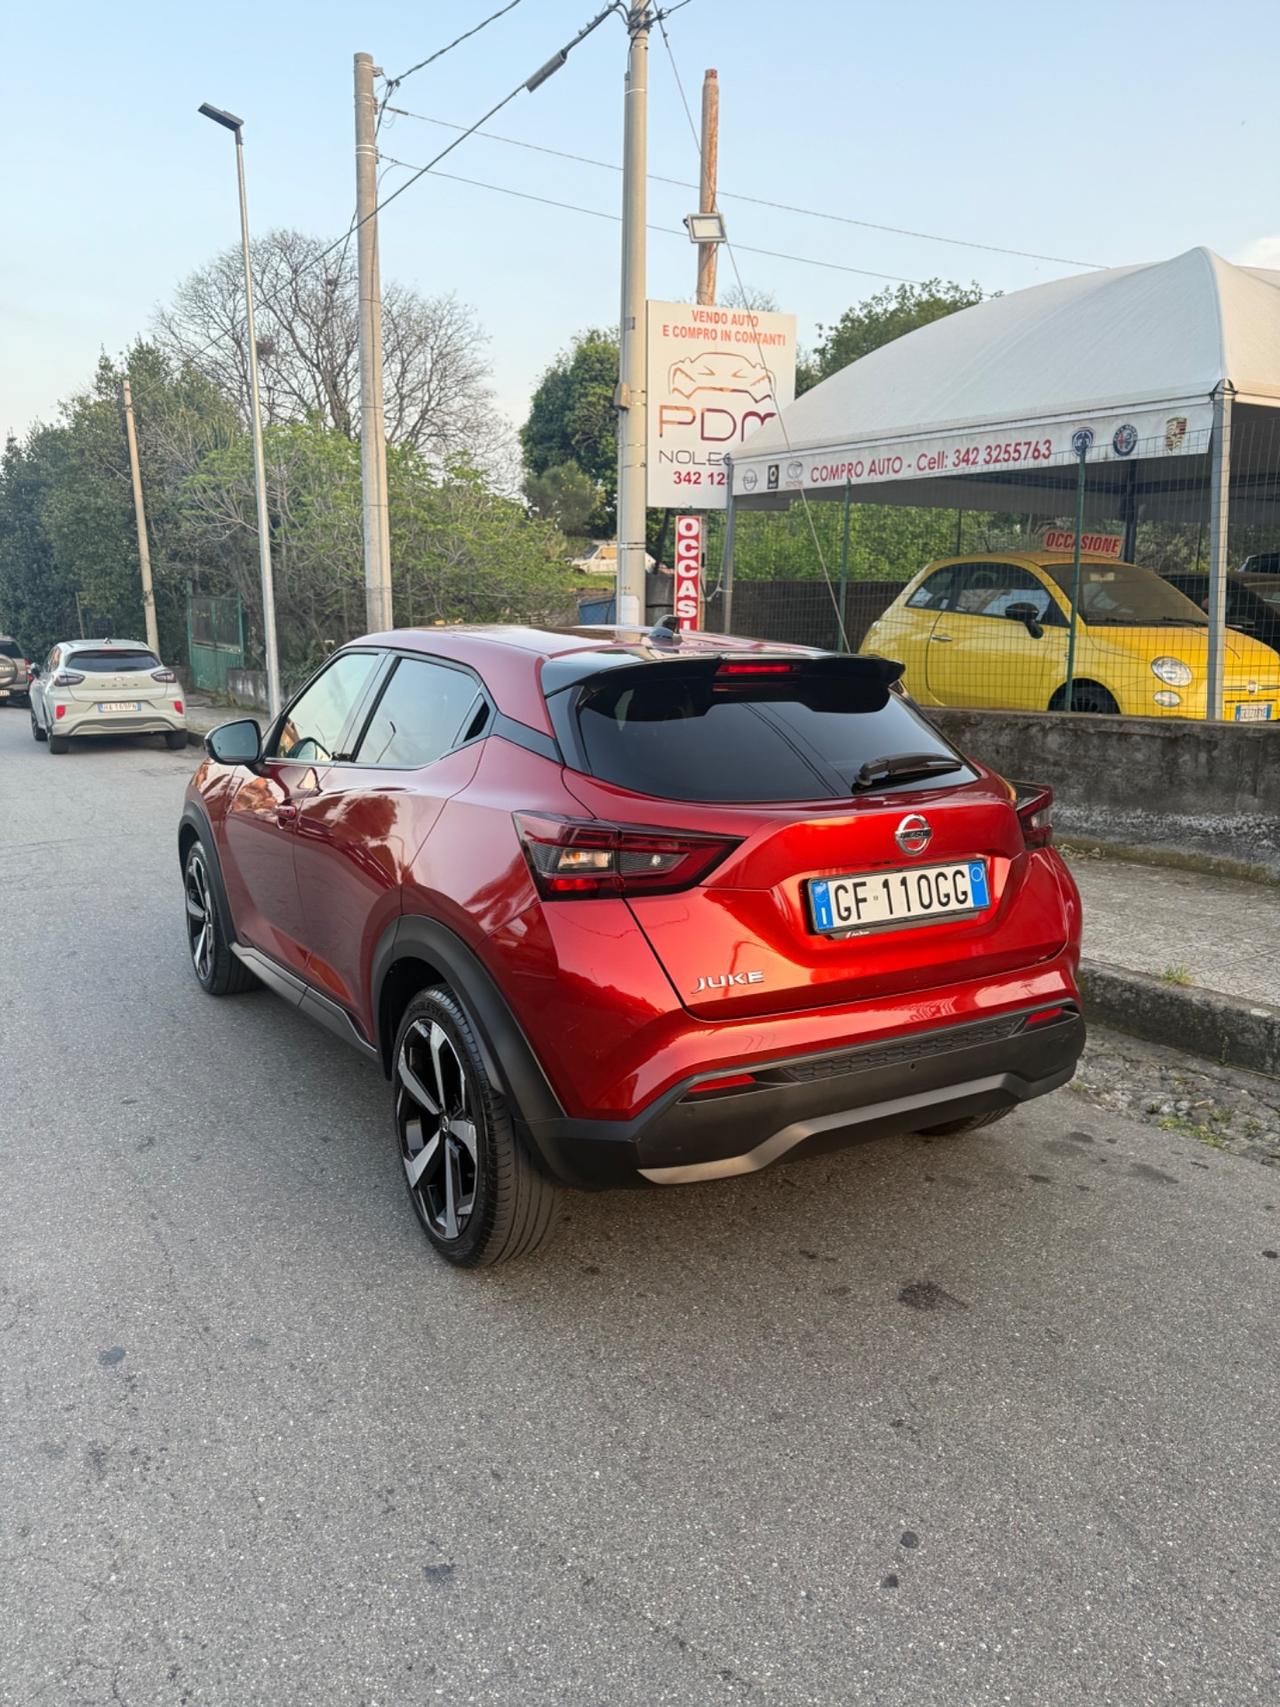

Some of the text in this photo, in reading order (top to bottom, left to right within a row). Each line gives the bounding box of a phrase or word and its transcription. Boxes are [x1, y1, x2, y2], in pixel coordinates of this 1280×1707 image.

[691, 310, 759, 327] VENDO AUTO
[662, 324, 786, 346] E COMPRO IN CONTANTI
[810, 461, 864, 483] COMPRO
[868, 456, 903, 477] AUTO
[916, 450, 949, 471] Cell:
[952, 446, 980, 468] 342
[983, 439, 1052, 465] 3255763
[673, 470, 702, 485] 342
[707, 471, 729, 486] 12
[1046, 532, 1120, 554] OCCSIONE
[690, 970, 766, 995] JUKE
